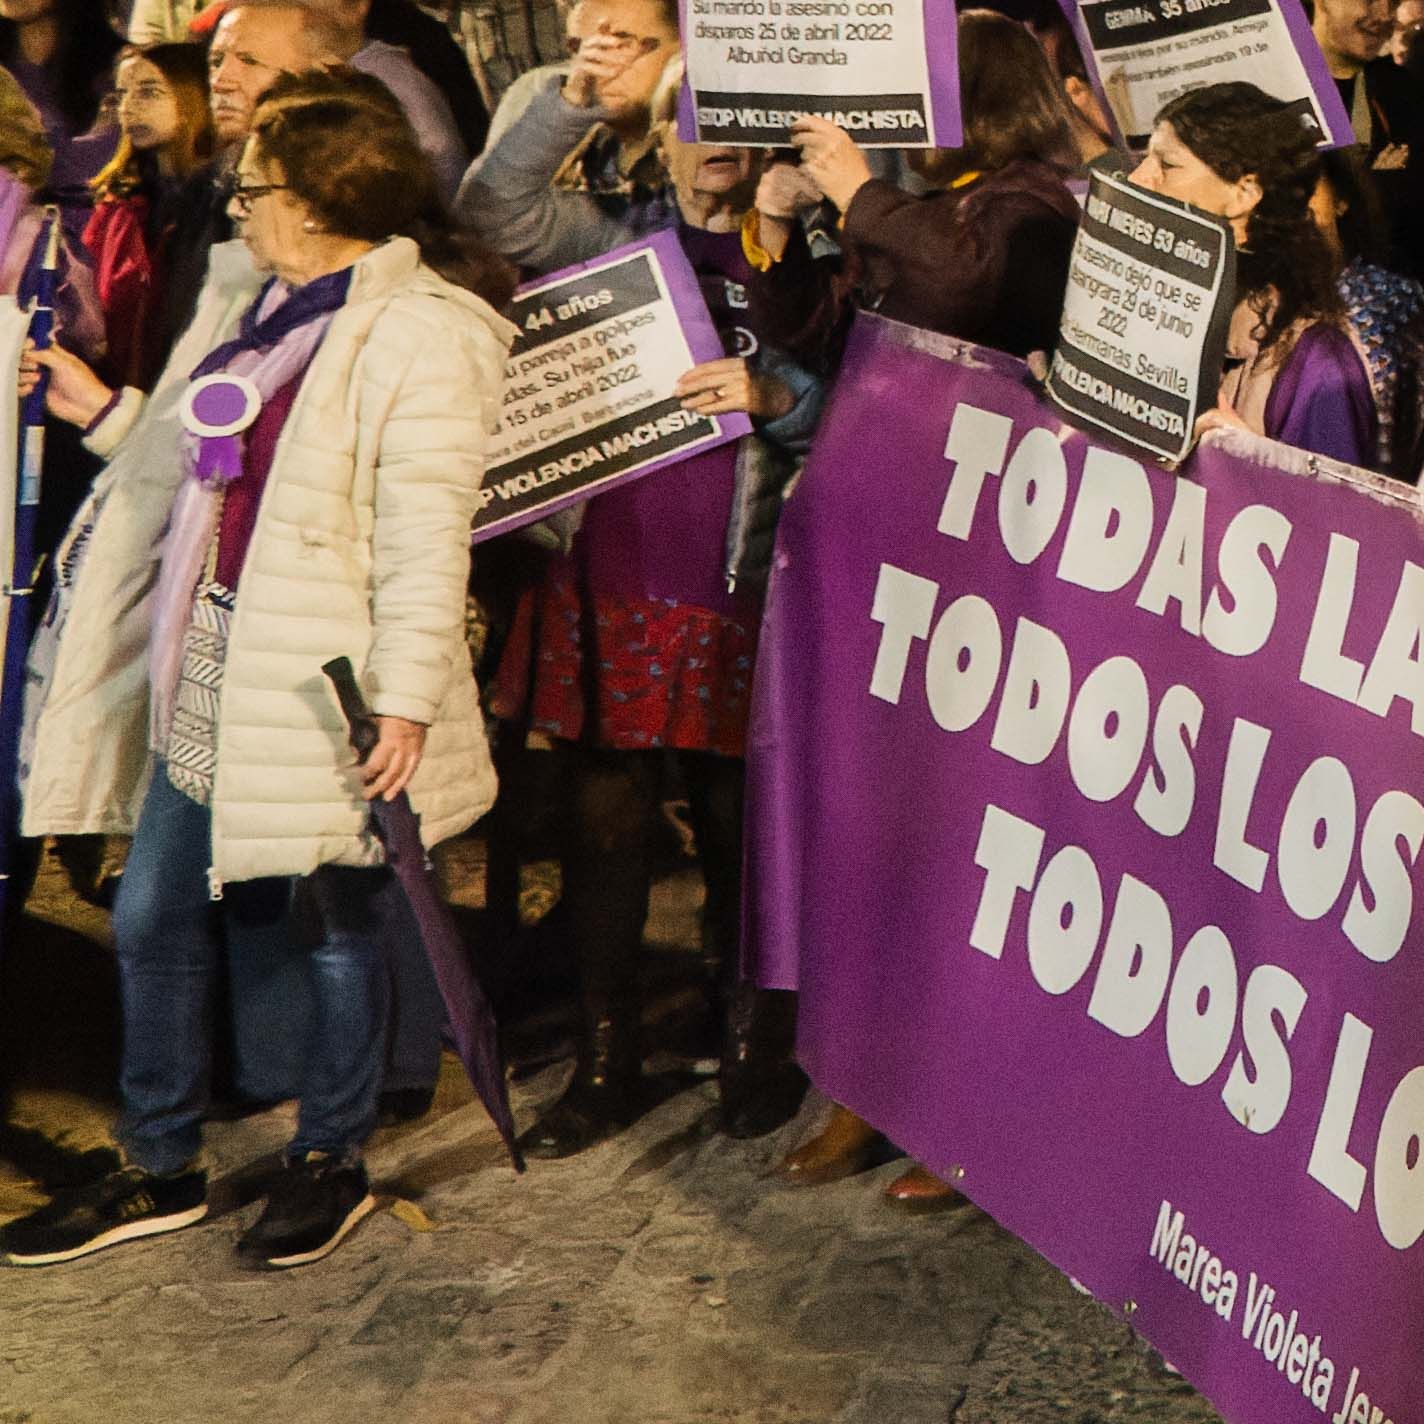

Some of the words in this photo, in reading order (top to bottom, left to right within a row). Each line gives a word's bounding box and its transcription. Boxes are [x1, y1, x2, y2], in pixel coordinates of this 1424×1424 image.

[786, 0, 850, 16] asesinó
[856, 3, 893, 16] con
[1160, 0, 1182, 20] 35
[695, 23, 755, 42] disparos
[758, 23, 777, 39] 25
[781, 23, 800, 39] de
[805, 23, 838, 40] abril
[846, 24, 893, 41] 2022
[736, 109, 812, 127] VIOLENC
[1174, 237, 1211, 269] años
[525, 308, 554, 331] 44
[557, 289, 614, 321] años
[1138, 296, 1156, 322] de
[1155, 307, 1193, 339] junio
[1154, 282, 1181, 305] que
[1184, 292, 1201, 313] se
[520, 343, 577, 377] pareja
[594, 311, 657, 346] golpes
[545, 370, 570, 388] Su
[571, 355, 604, 380] hija
[606, 341, 637, 363] fue
[530, 398, 552, 420] de
[557, 382, 598, 410] abril
[599, 363, 643, 393] 2022
[1135, 353, 1189, 394] Sevilla
[499, 445, 604, 501] VIOLENCIA
[936, 402, 1293, 657] TODAS
[868, 562, 1205, 837] TODOS
[968, 803, 1309, 1135] TODOS
[1150, 1199, 1239, 1323] Marea
[1241, 1272, 1336, 1414] Violeta
